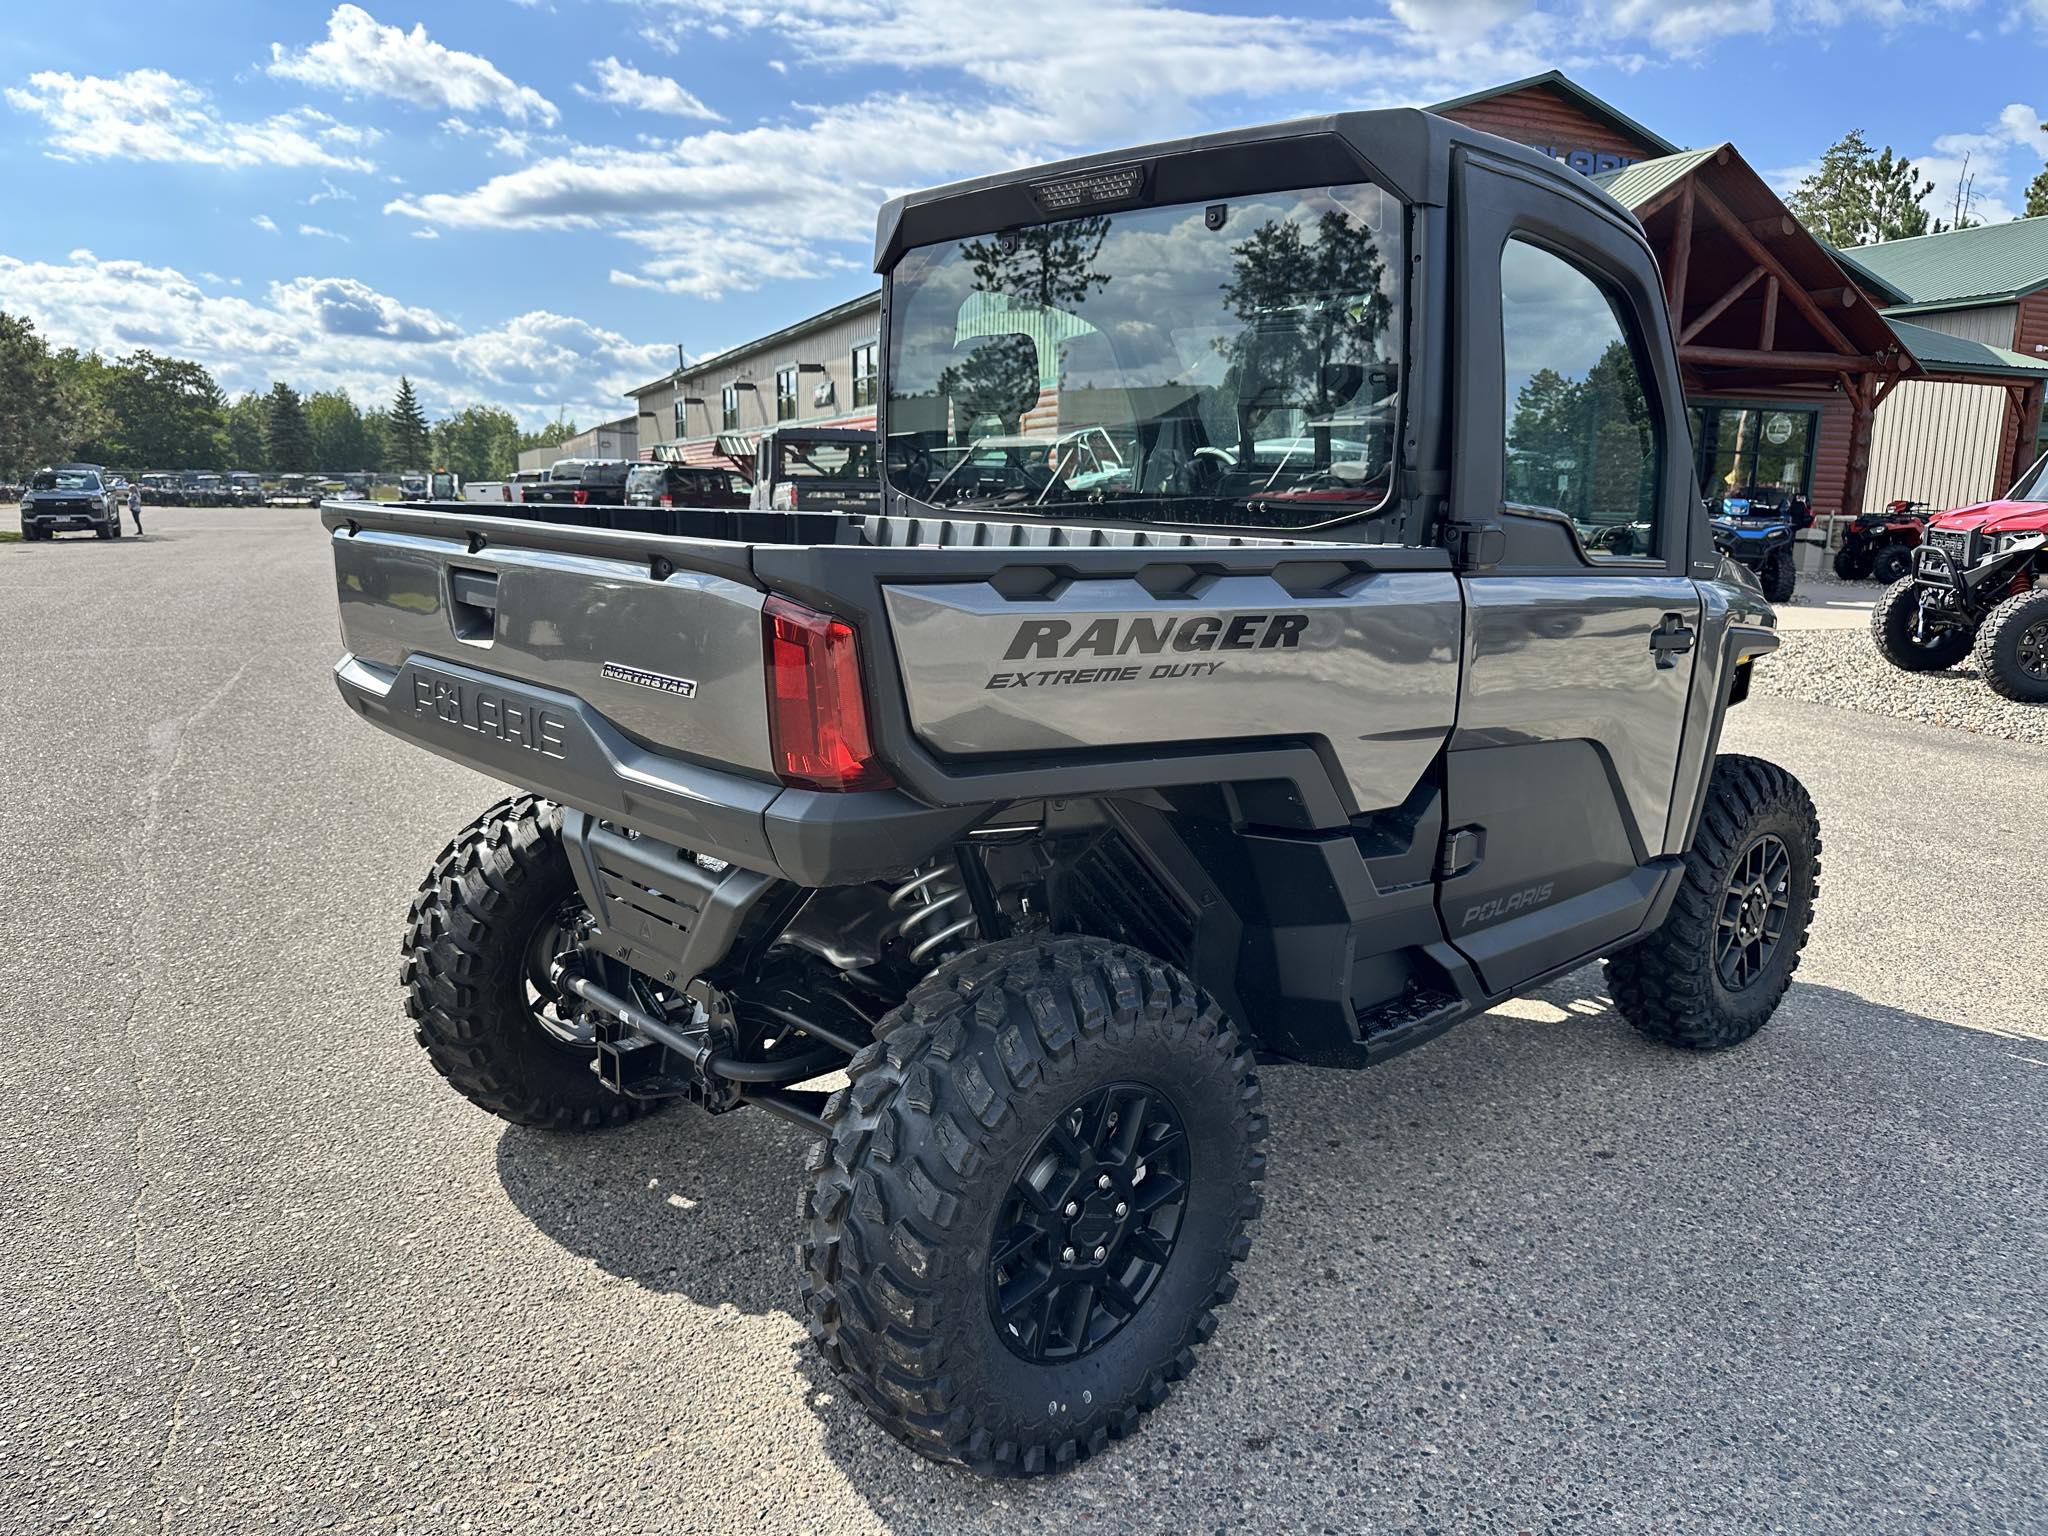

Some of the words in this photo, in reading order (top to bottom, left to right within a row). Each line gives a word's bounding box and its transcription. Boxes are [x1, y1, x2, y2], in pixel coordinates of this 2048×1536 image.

[1931, 538, 1963, 550] POLARIS
[1002, 614, 1309, 660] RANGER
[604, 665, 690, 695] NORTHSTAR
[984, 666, 1142, 690] EXTREME
[1149, 661, 1225, 680] DUTY
[413, 672, 567, 760] POLARIS
[1462, 882, 1554, 927] POLARIS
